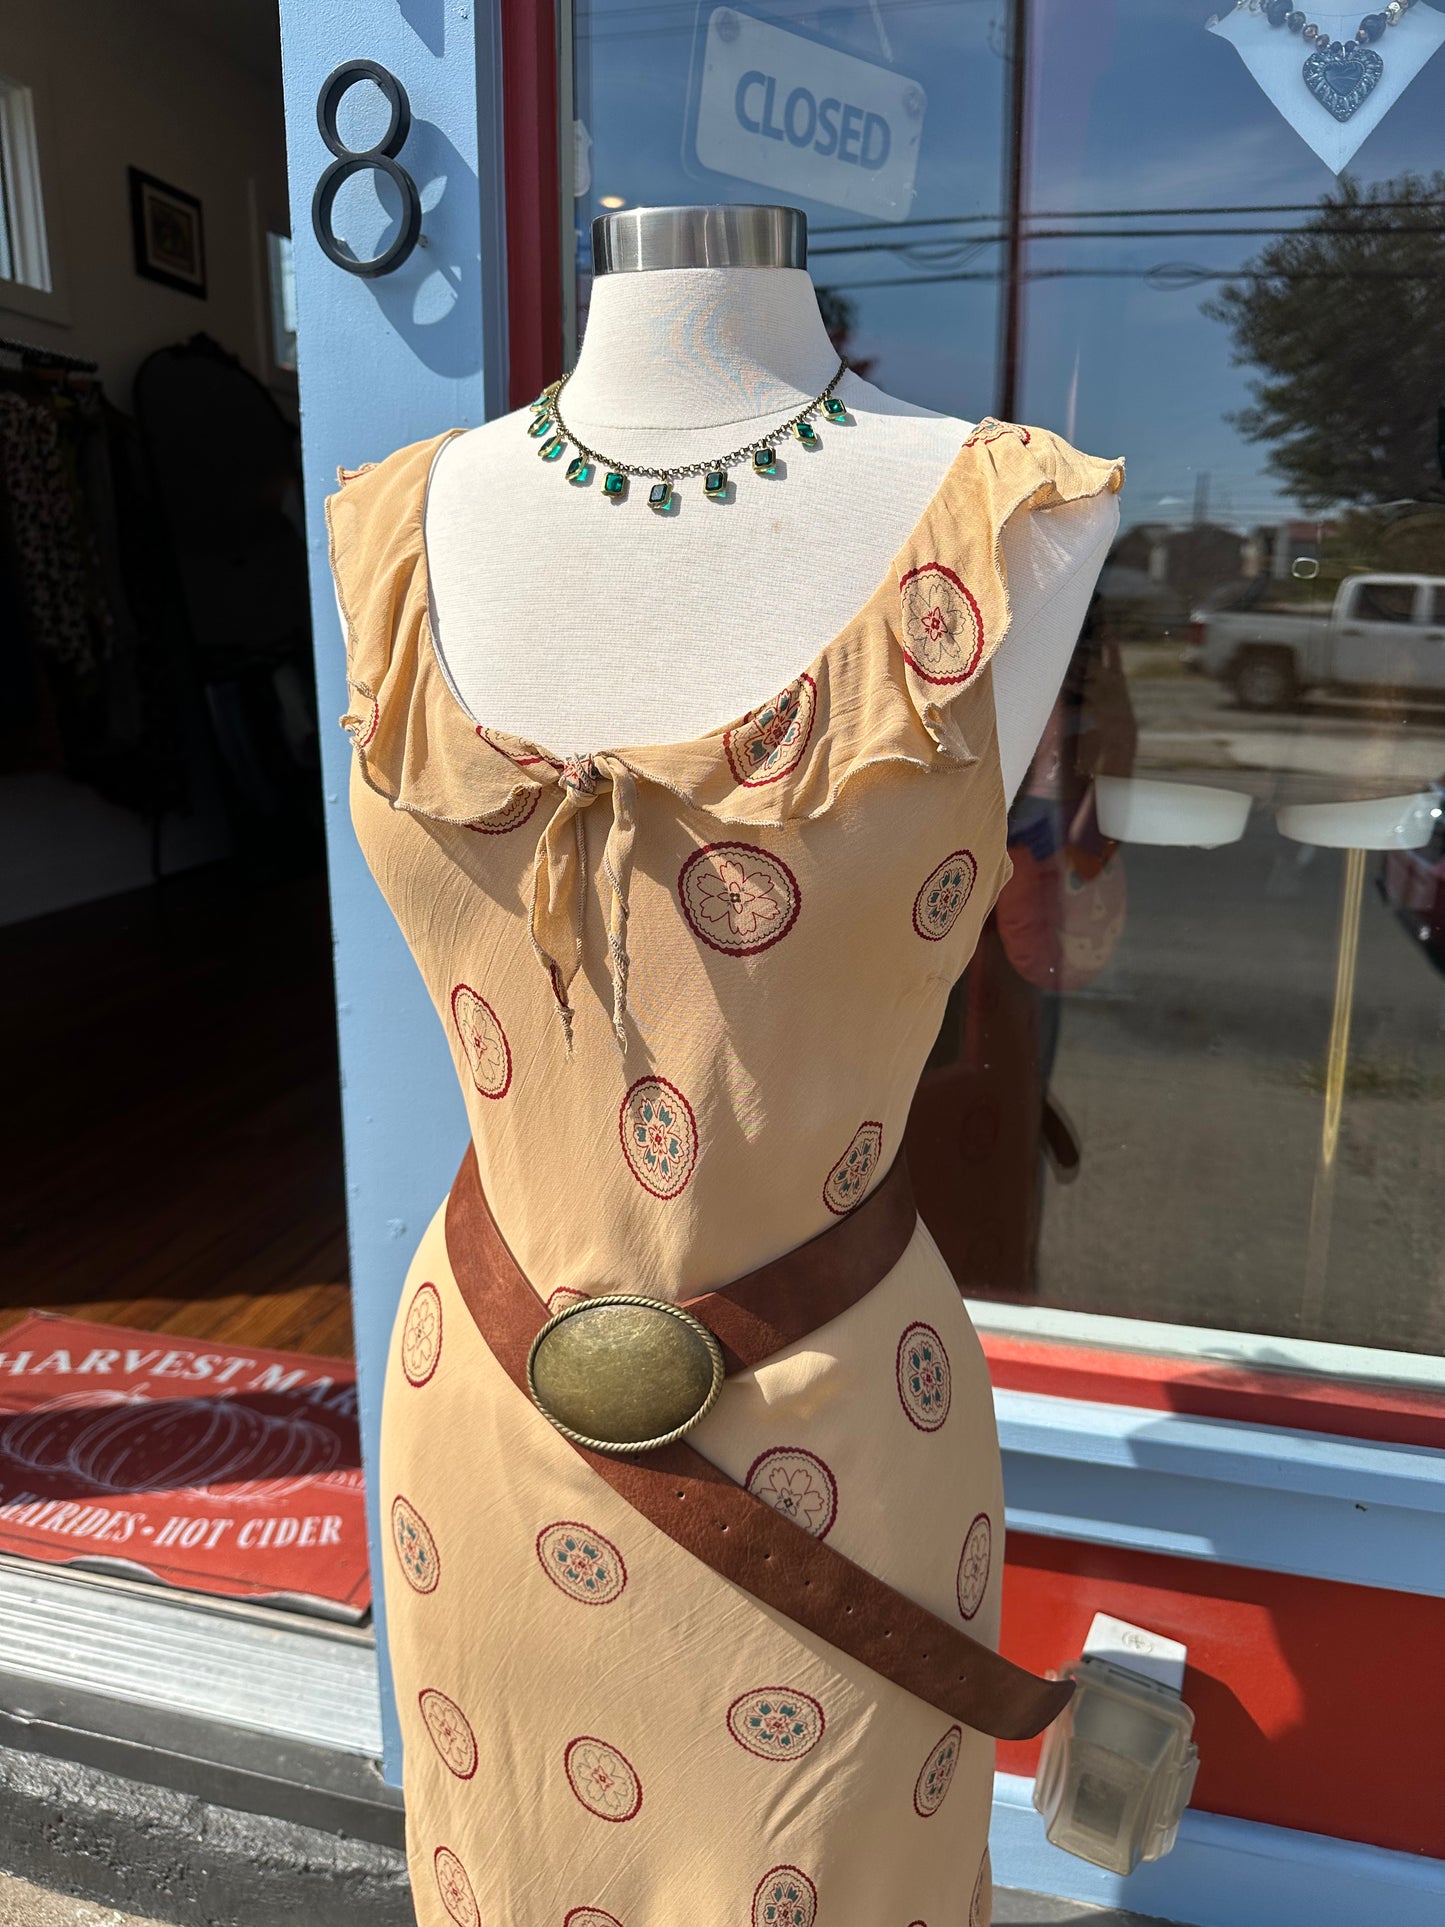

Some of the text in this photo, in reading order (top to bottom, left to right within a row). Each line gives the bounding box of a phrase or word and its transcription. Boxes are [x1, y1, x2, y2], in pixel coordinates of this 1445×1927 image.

[312, 59, 422, 278] 8
[735, 70, 891, 170] CLOSED
[152, 1516, 235, 1549] HOT
[236, 1515, 344, 1549] CIDER
